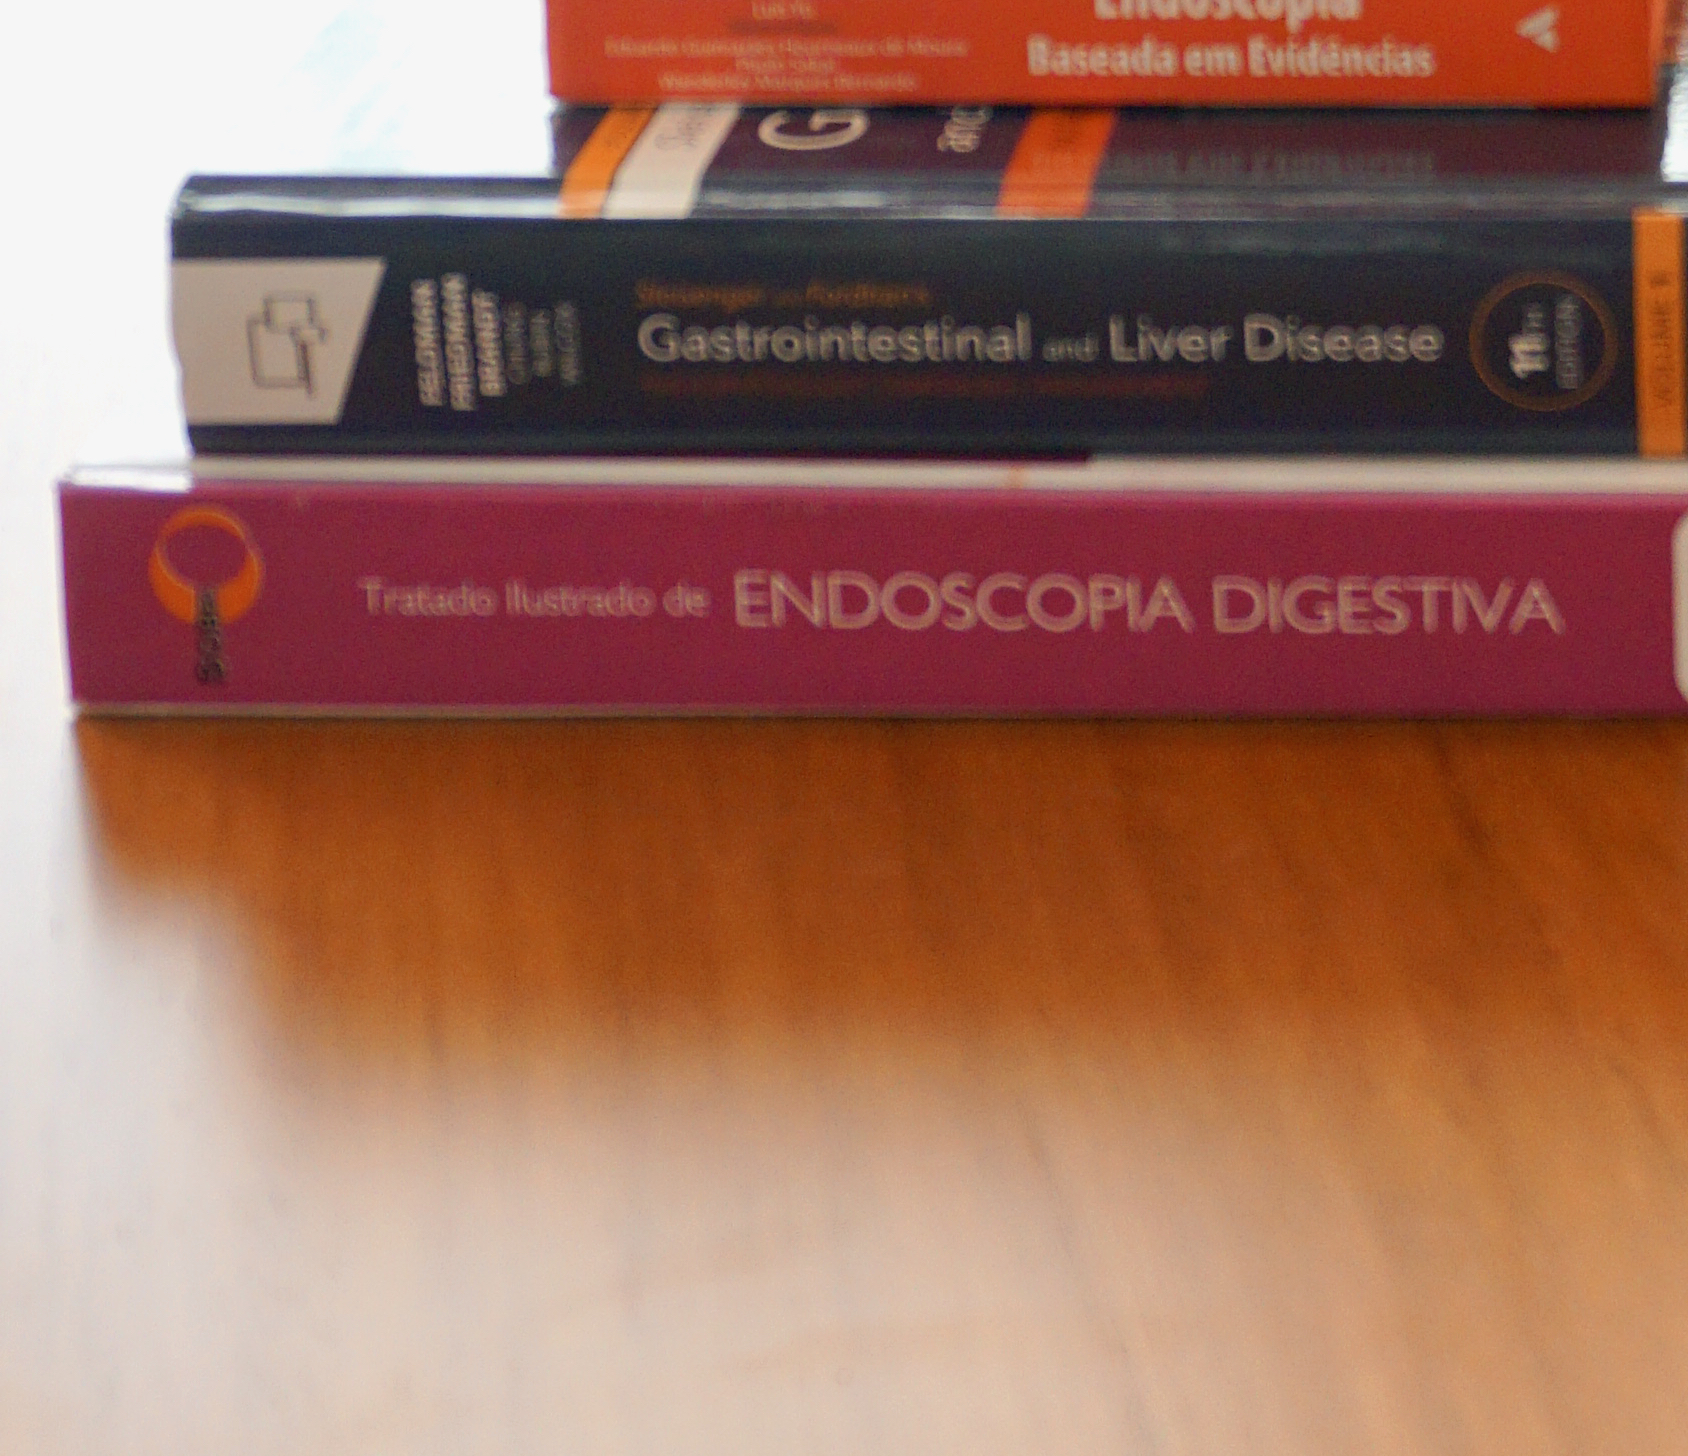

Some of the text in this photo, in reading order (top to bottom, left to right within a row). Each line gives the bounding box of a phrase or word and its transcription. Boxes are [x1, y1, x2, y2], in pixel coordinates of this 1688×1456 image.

[1026, 32, 1438, 78] Baseada em Evidências
[637, 311, 1446, 364] Gastrointestinal and Liver Disease
[357, 567, 1568, 636] Tratado Ilustrado de ENDOSCOPIA DIGESTIVA
